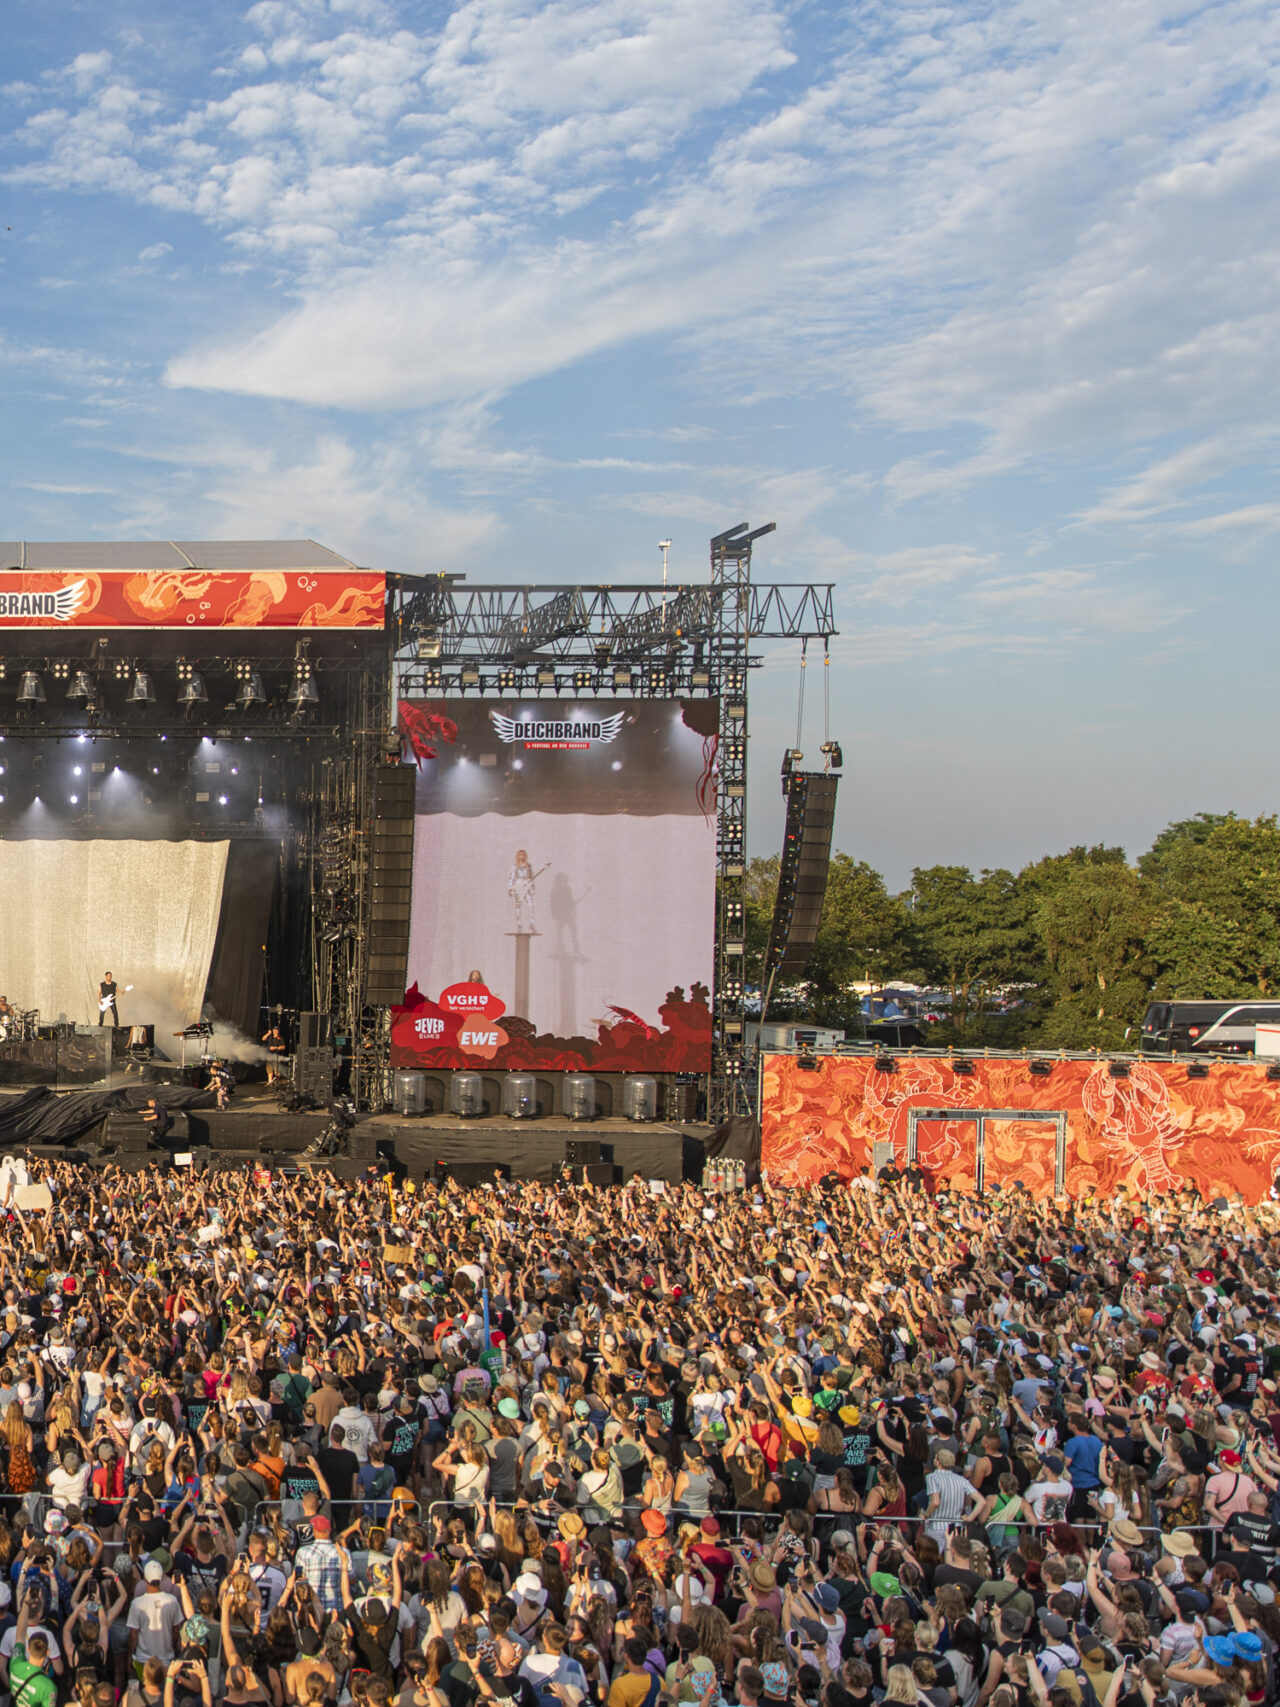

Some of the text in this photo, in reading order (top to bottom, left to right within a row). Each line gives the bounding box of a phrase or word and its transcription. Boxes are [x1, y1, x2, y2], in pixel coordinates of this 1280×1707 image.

[514, 722, 601, 739] DEICHBRAND
[447, 995, 477, 1005] VGH
[415, 1017, 445, 1034] JEVER
[461, 1032, 499, 1046] EWE
